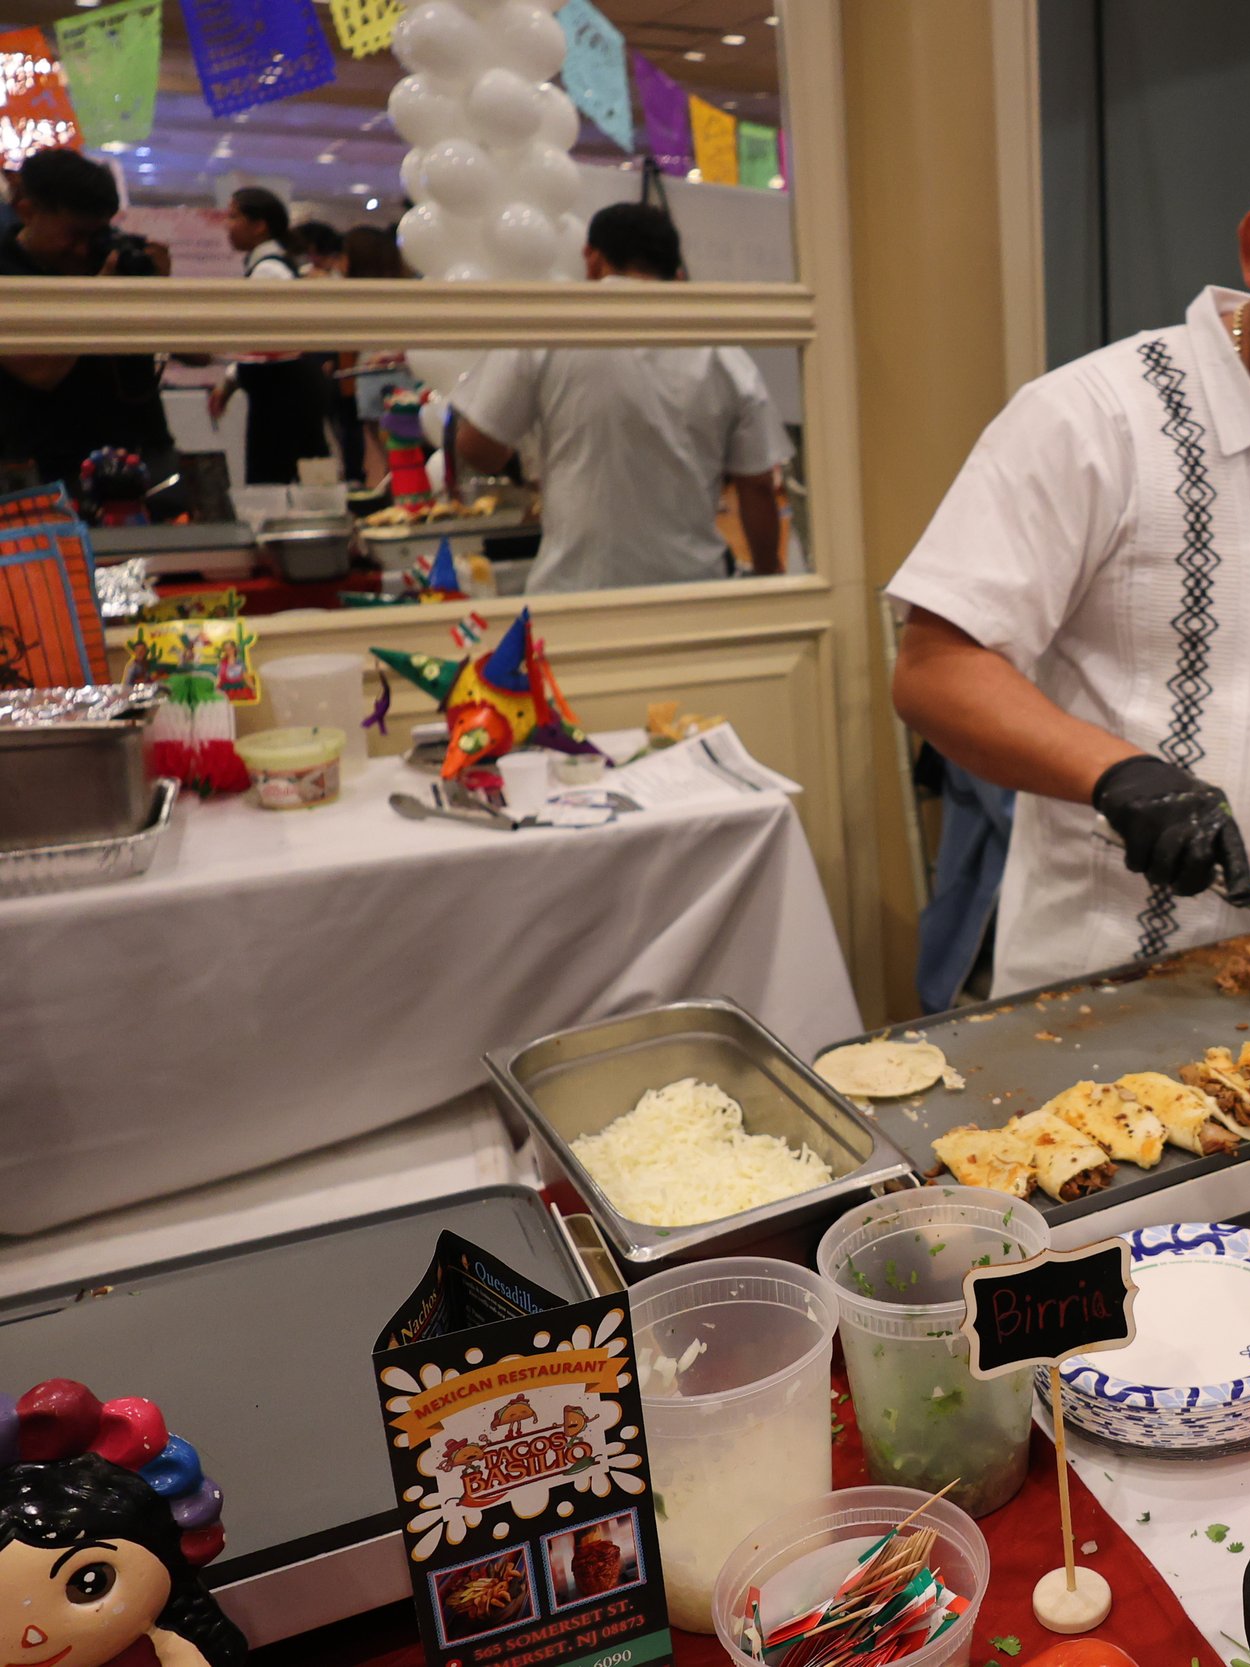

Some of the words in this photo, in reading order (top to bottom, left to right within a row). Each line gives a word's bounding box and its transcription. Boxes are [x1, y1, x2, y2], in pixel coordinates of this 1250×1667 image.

[401, 1289, 437, 1345] Nachos
[993, 1280, 1112, 1344] Birria
[414, 1377, 493, 1420] MEXICAN
[497, 1360, 608, 1386] RESTAURANT
[460, 1441, 594, 1496] BASILIO
[482, 1432, 567, 1470] TACOS
[474, 1644, 501, 1661] 565
[505, 1609, 603, 1652] SOMERSET
[607, 1600, 635, 1618] ST.
[576, 1627, 598, 1648] NJ
[602, 1614, 645, 1639] 08873
